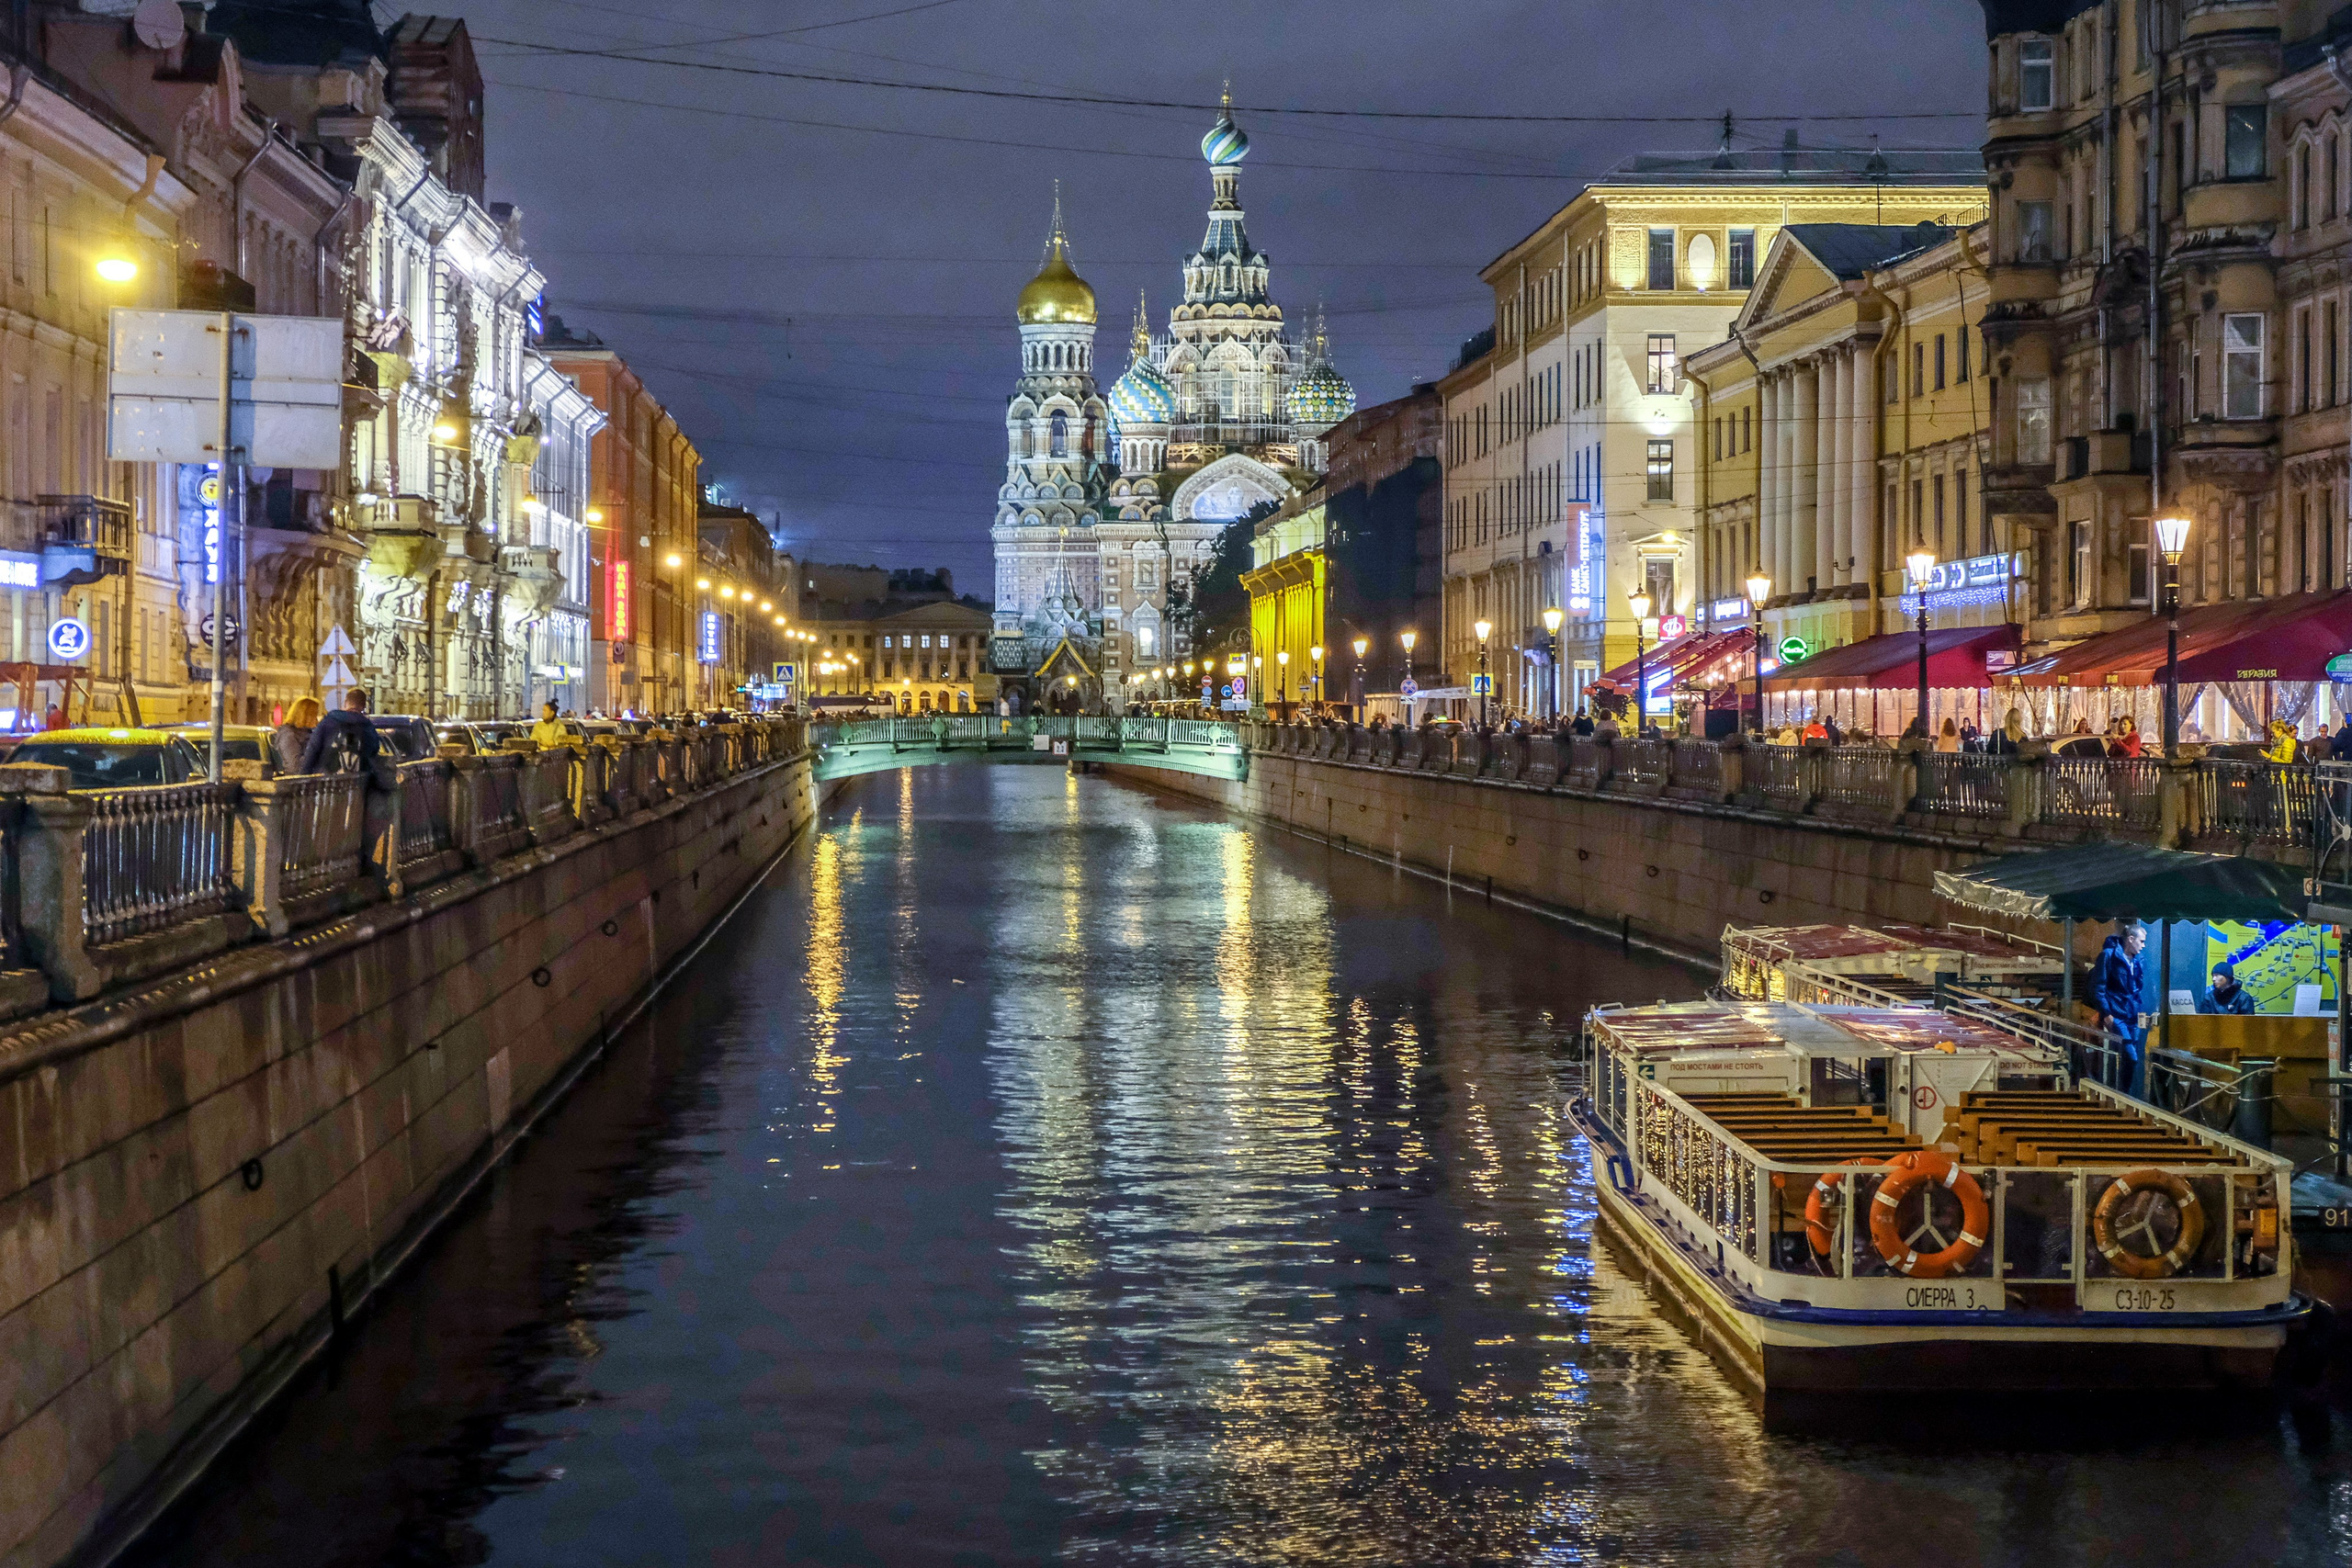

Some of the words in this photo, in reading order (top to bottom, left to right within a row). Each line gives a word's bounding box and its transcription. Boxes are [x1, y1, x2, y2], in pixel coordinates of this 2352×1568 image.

[616, 563, 627, 599] MAMA
[1571, 568, 1580, 595] БАНК
[2236, 669, 2278, 679] ЕВРАЗИЯ
[2324, 1208, 2348, 1227] 91
[1906, 1287, 1956, 1307] СИЕРРА
[1966, 1288, 1974, 1308] 3
